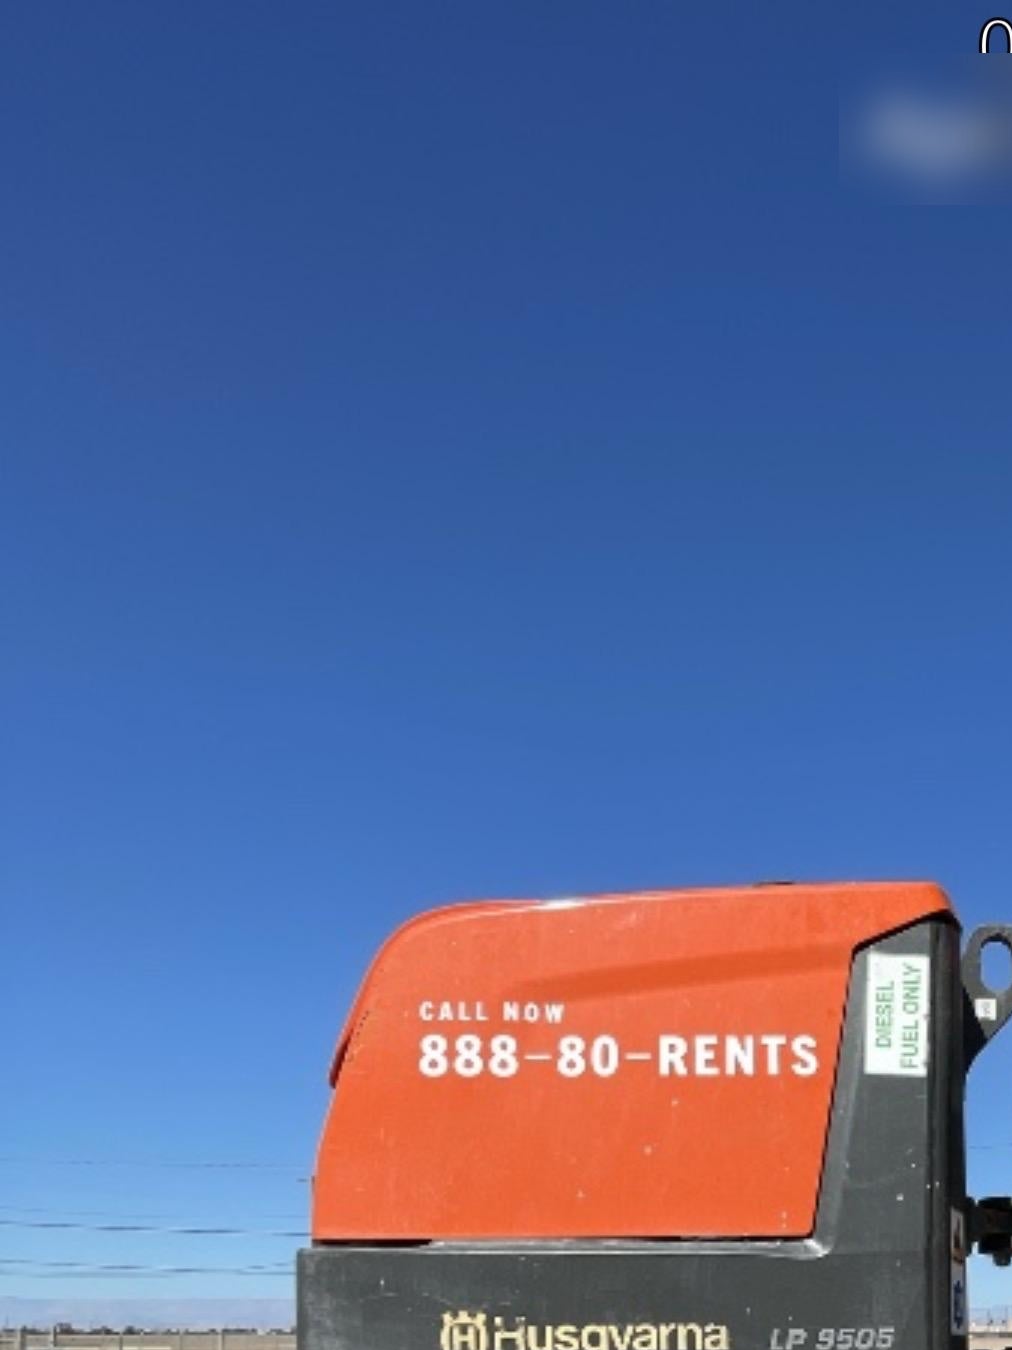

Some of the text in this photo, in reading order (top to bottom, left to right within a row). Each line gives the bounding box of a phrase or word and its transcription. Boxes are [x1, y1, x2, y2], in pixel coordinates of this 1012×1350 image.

[419, 1001, 565, 1024] CALL NOW
[875, 980, 895, 1048] DIESEL
[900, 962, 922, 1069] FUEL ONLY
[418, 1034, 819, 1078] 888-80-RENTS
[770, 1326, 896, 1350] LP 9505
